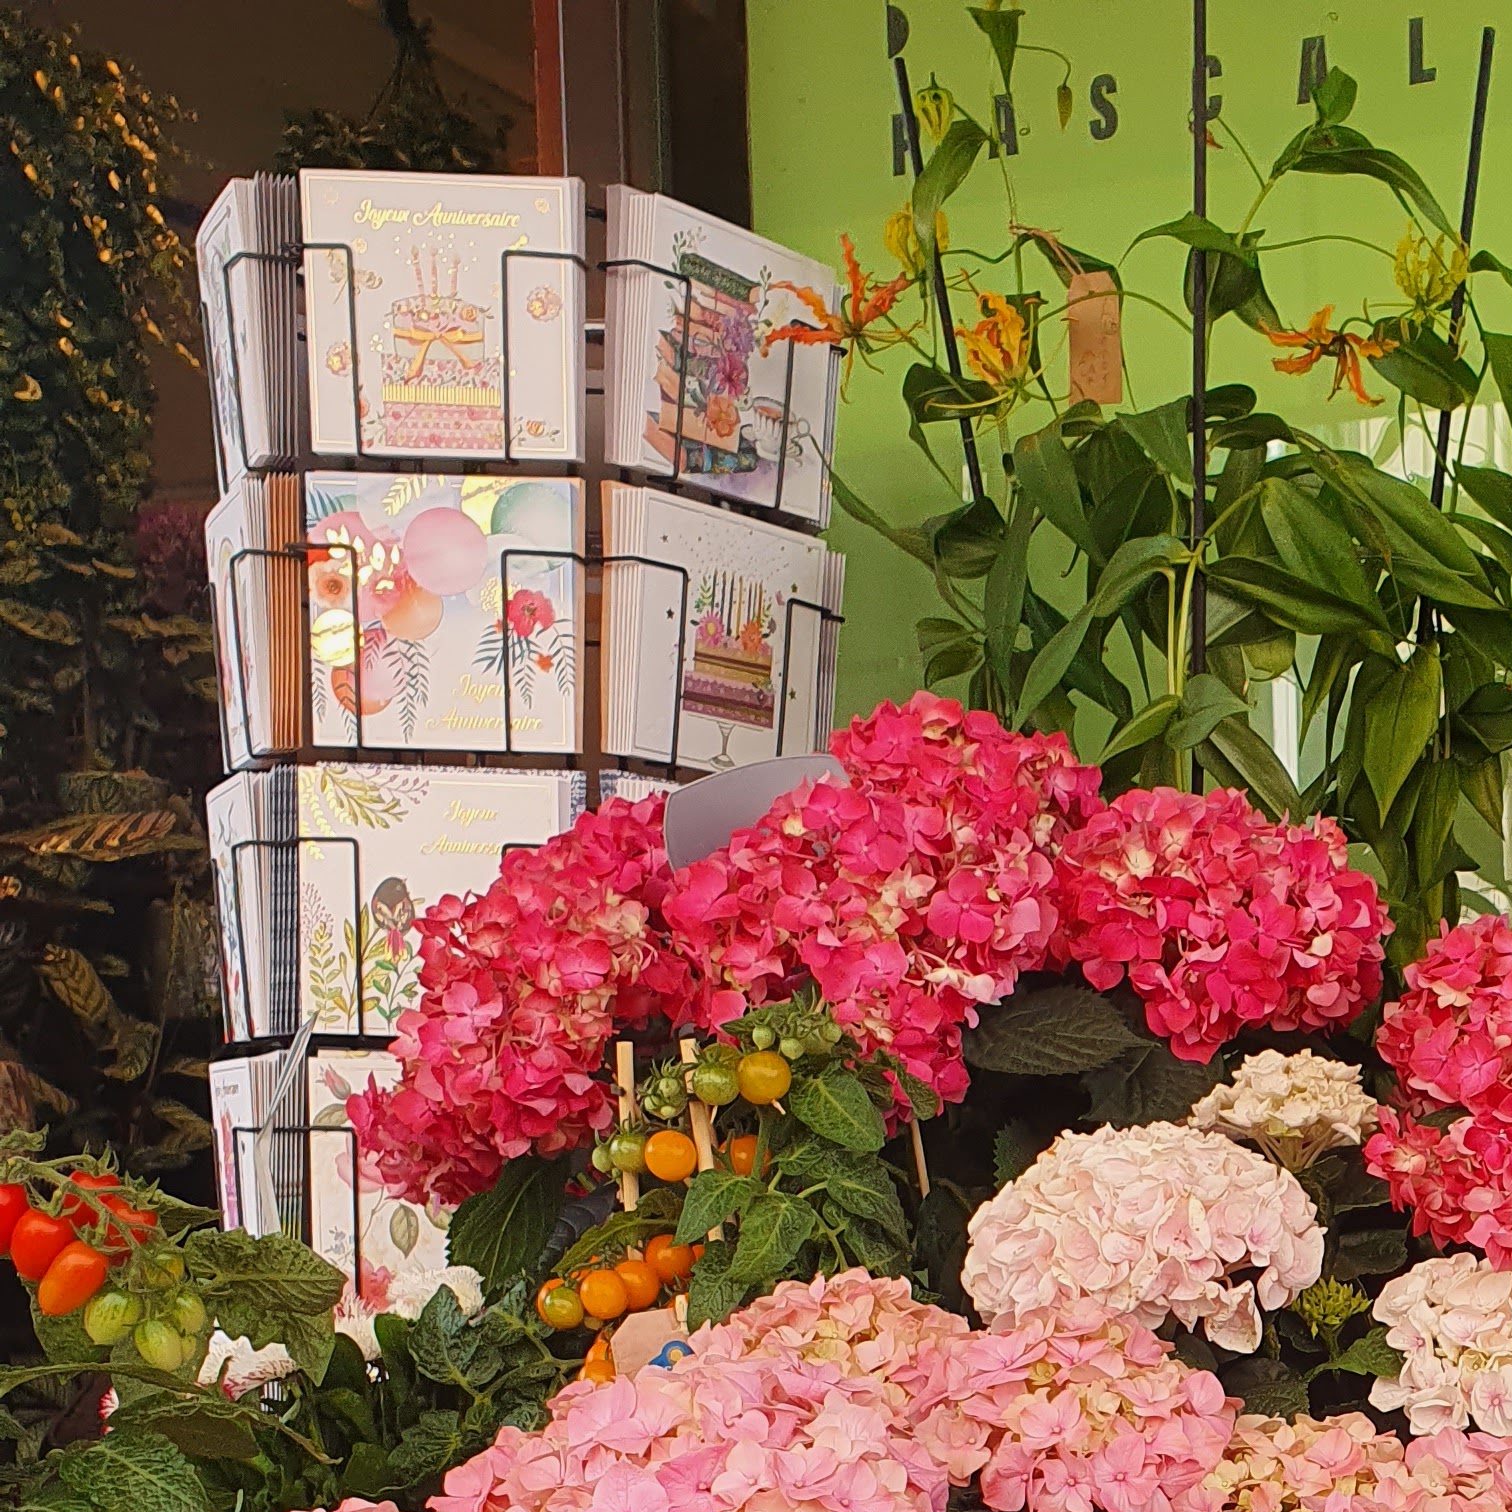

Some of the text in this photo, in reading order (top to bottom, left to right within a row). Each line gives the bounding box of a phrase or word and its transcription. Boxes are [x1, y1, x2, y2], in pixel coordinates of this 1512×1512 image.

[353, 199, 521, 230] Joyeux Anniversaire
[452, 673, 508, 704] Joyeu
[425, 706, 542, 730] Anniveraire
